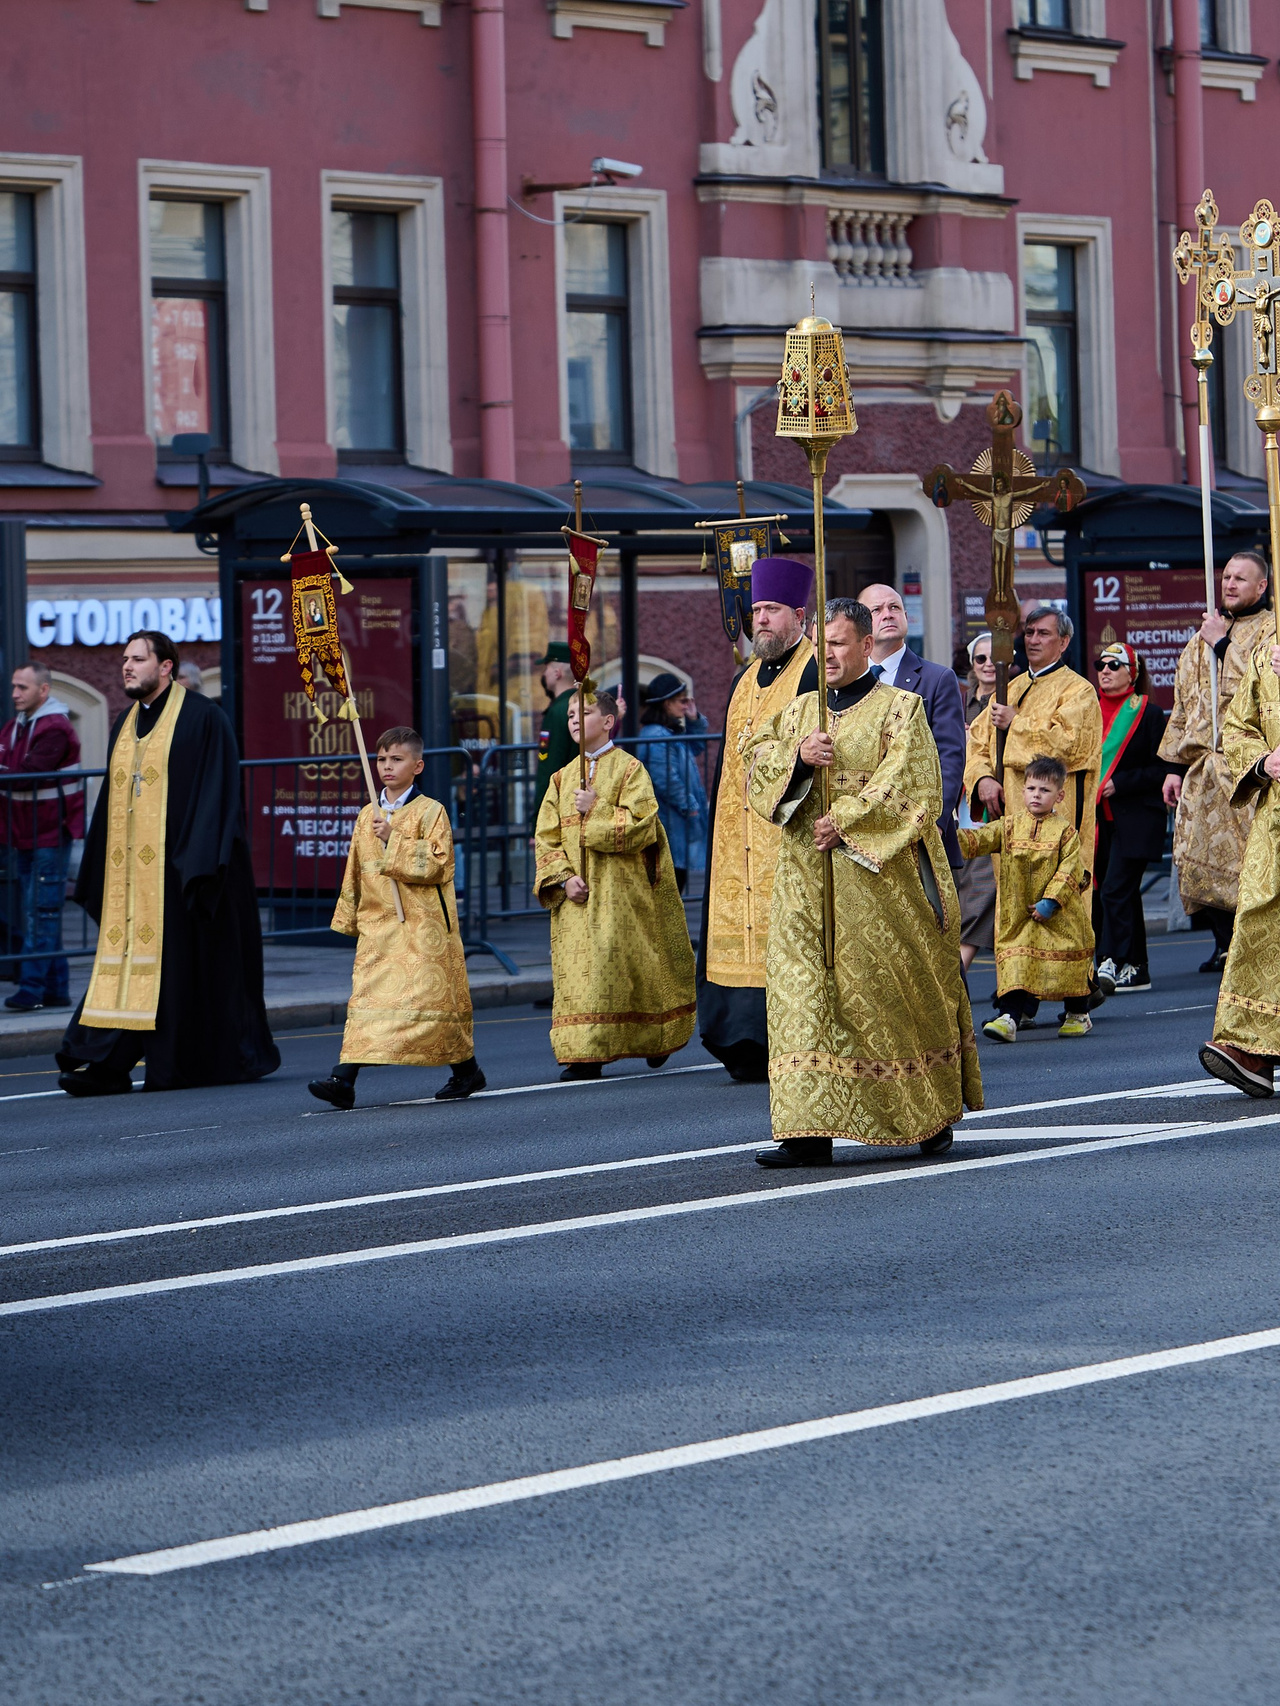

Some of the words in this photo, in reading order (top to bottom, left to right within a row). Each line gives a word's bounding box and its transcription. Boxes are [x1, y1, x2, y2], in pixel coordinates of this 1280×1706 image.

[361, 595, 382, 605] Вера
[1093, 576, 1121, 603] 12
[251, 587, 283, 620] 12
[1126, 626, 1196, 644] КРЕСТНЫЙ
[309, 723, 353, 755] ХОД
